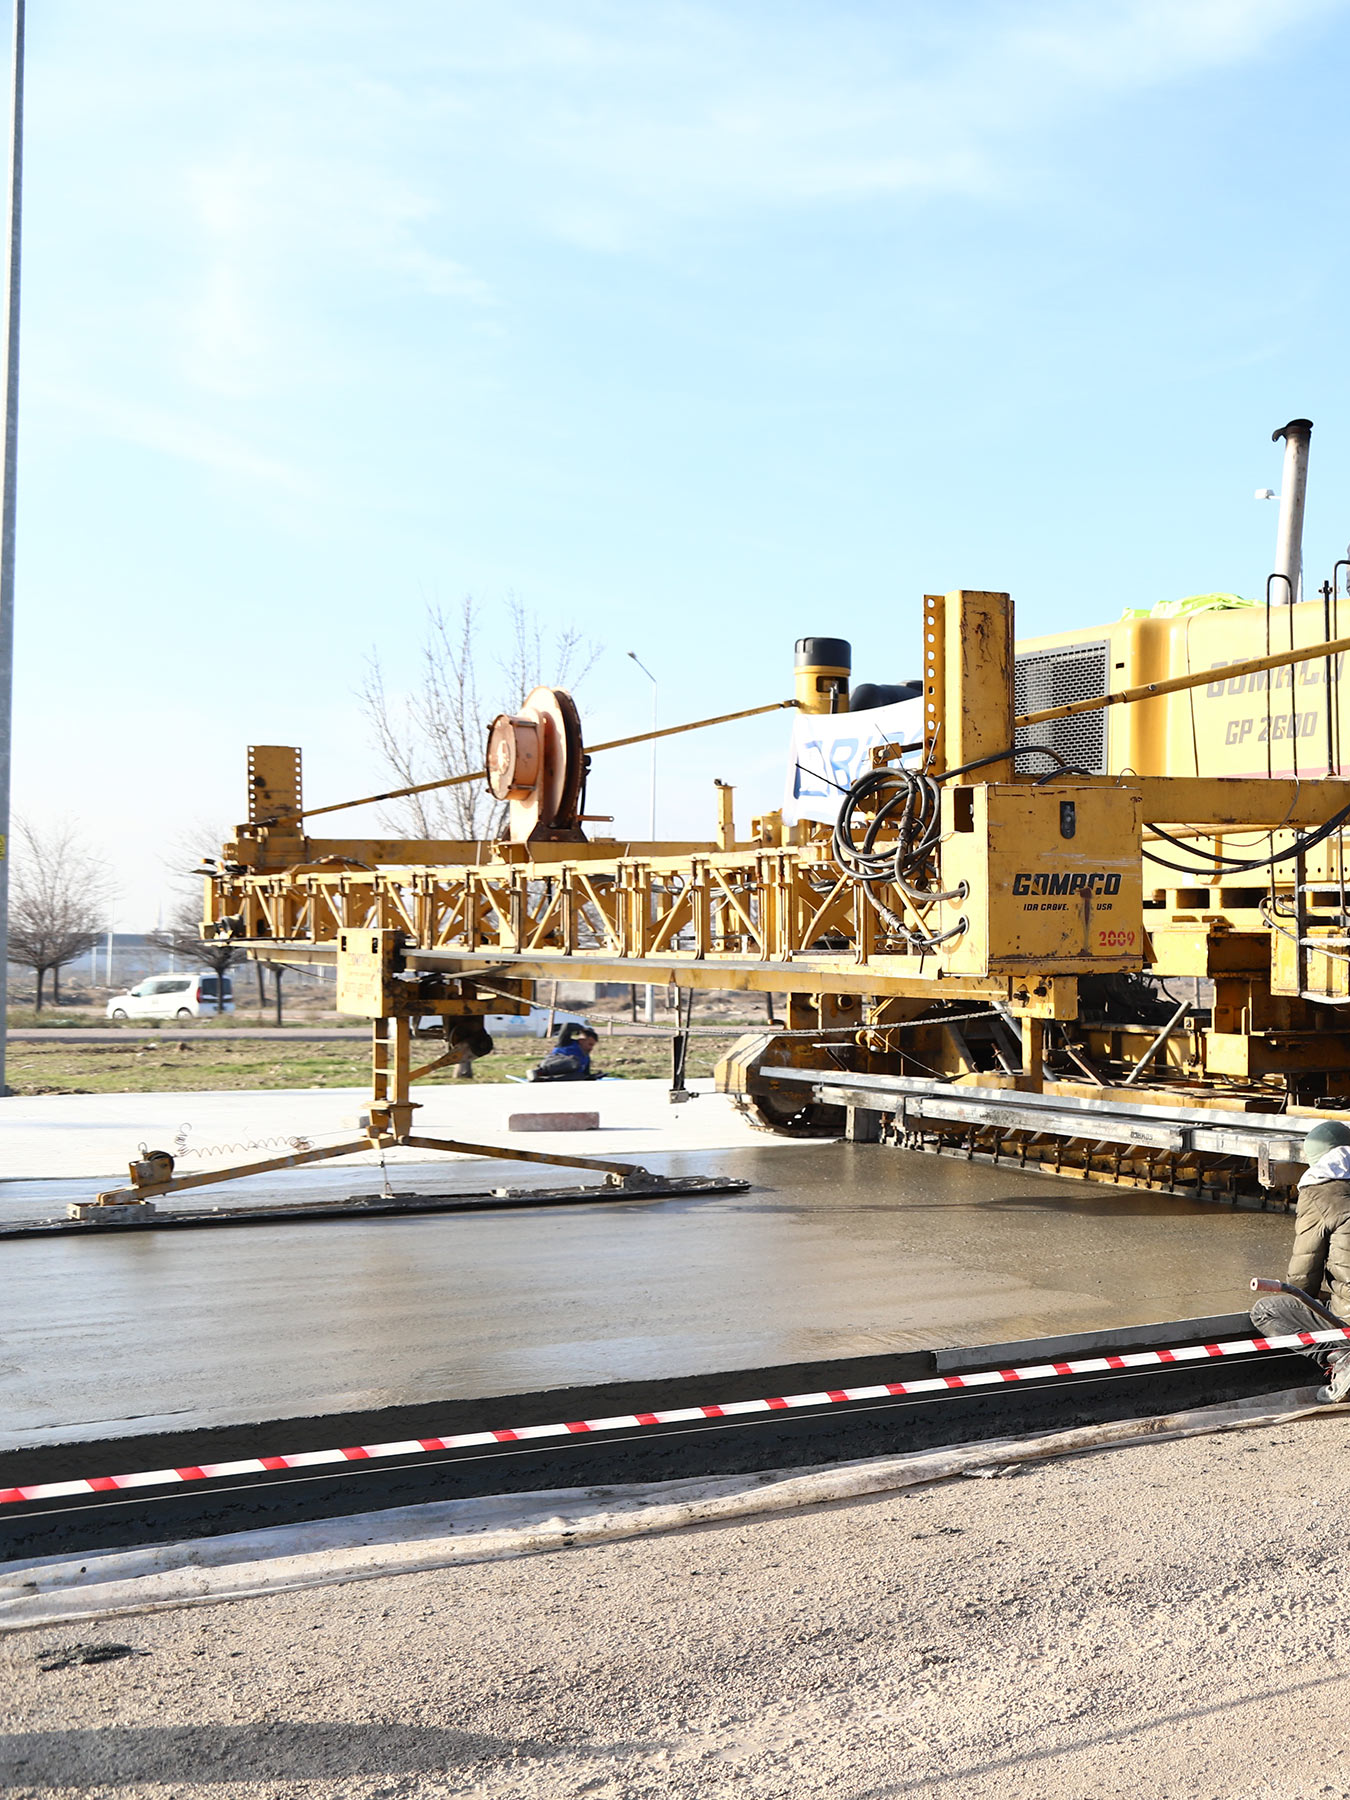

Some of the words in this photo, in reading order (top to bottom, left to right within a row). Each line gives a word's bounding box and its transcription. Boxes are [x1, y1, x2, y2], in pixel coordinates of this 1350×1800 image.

[1225, 718, 1253, 745] GP
[1257, 711, 1318, 742] 2600
[1012, 873, 1122, 896] GOMACO
[1023, 903, 1039, 911] IDA
[1096, 903, 1113, 911] USA
[1098, 930, 1135, 947] 2009
